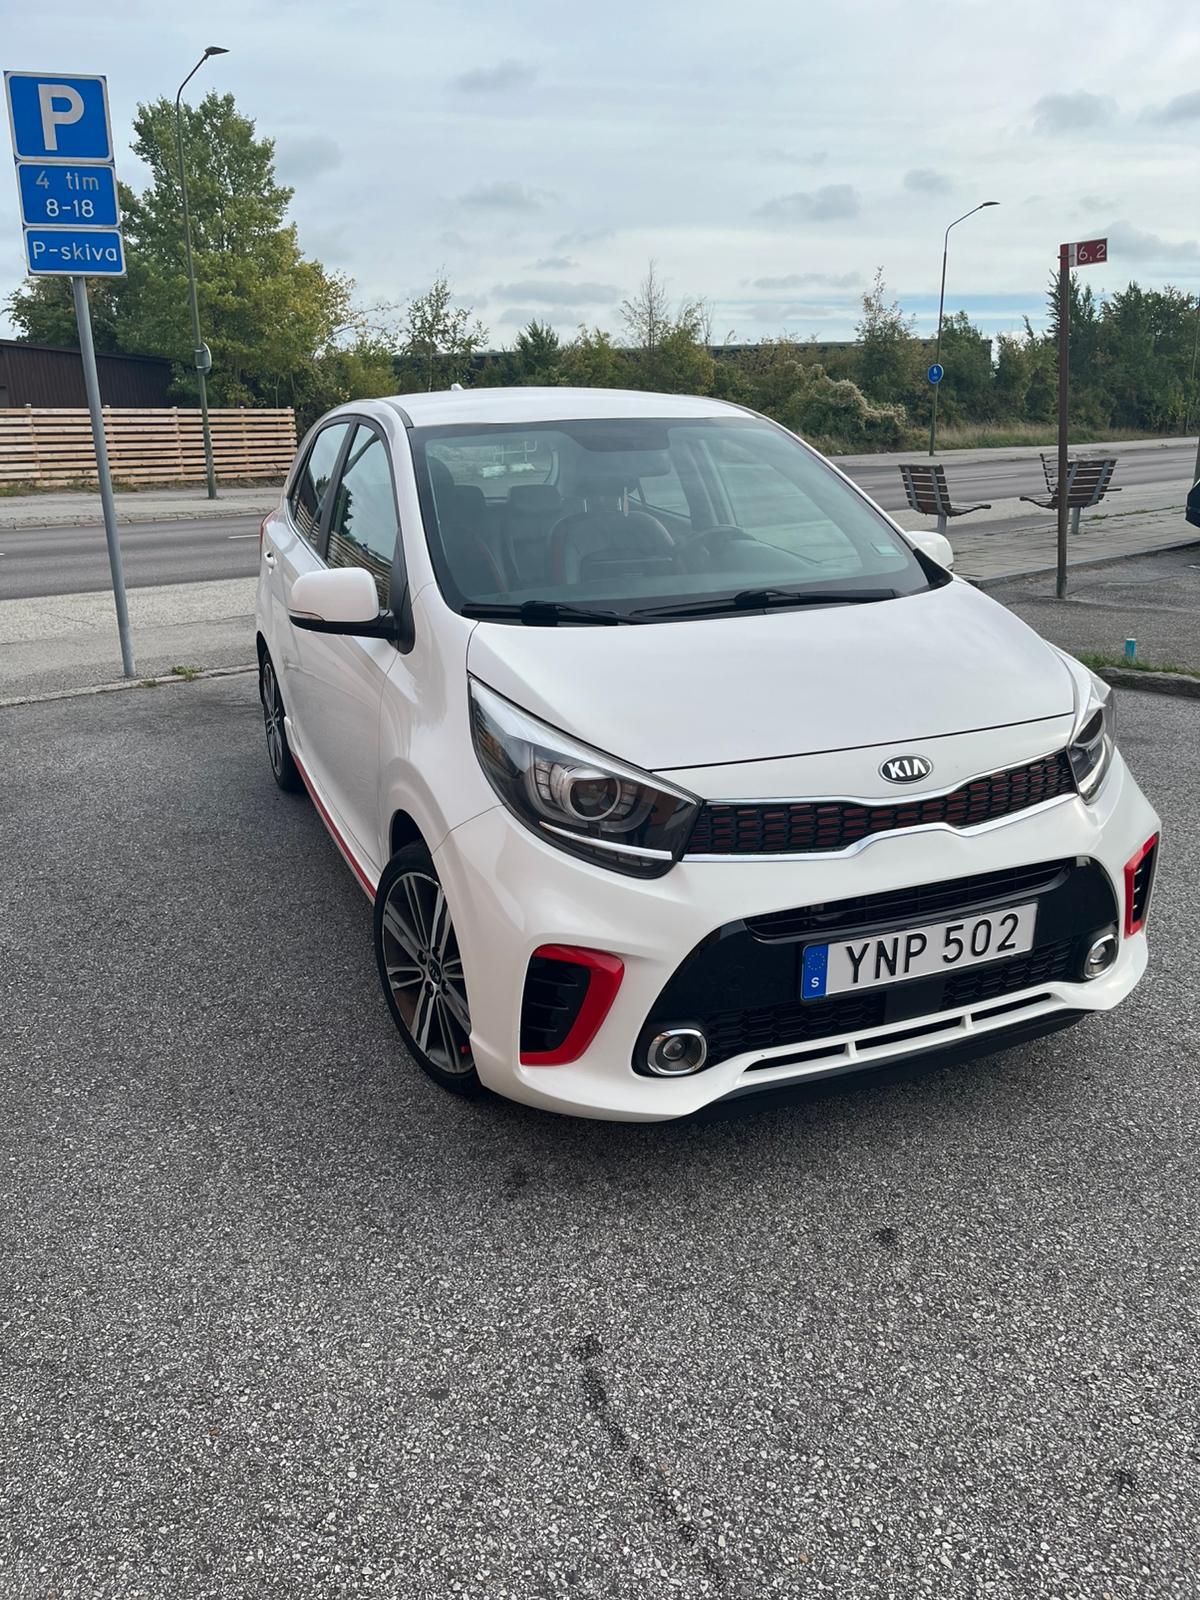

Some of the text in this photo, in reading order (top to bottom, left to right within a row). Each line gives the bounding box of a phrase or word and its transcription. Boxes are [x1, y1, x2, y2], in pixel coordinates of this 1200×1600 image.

[38, 83, 84, 151] P
[36, 171, 99, 190] 4 tim
[46, 199, 94, 218] 8-18
[33, 242, 118, 261] P-skiva
[1079, 244, 1106, 261] 6,2
[887, 758, 927, 779] KIA
[846, 913, 1019, 983] YNP 502
[811, 977, 820, 988] S
